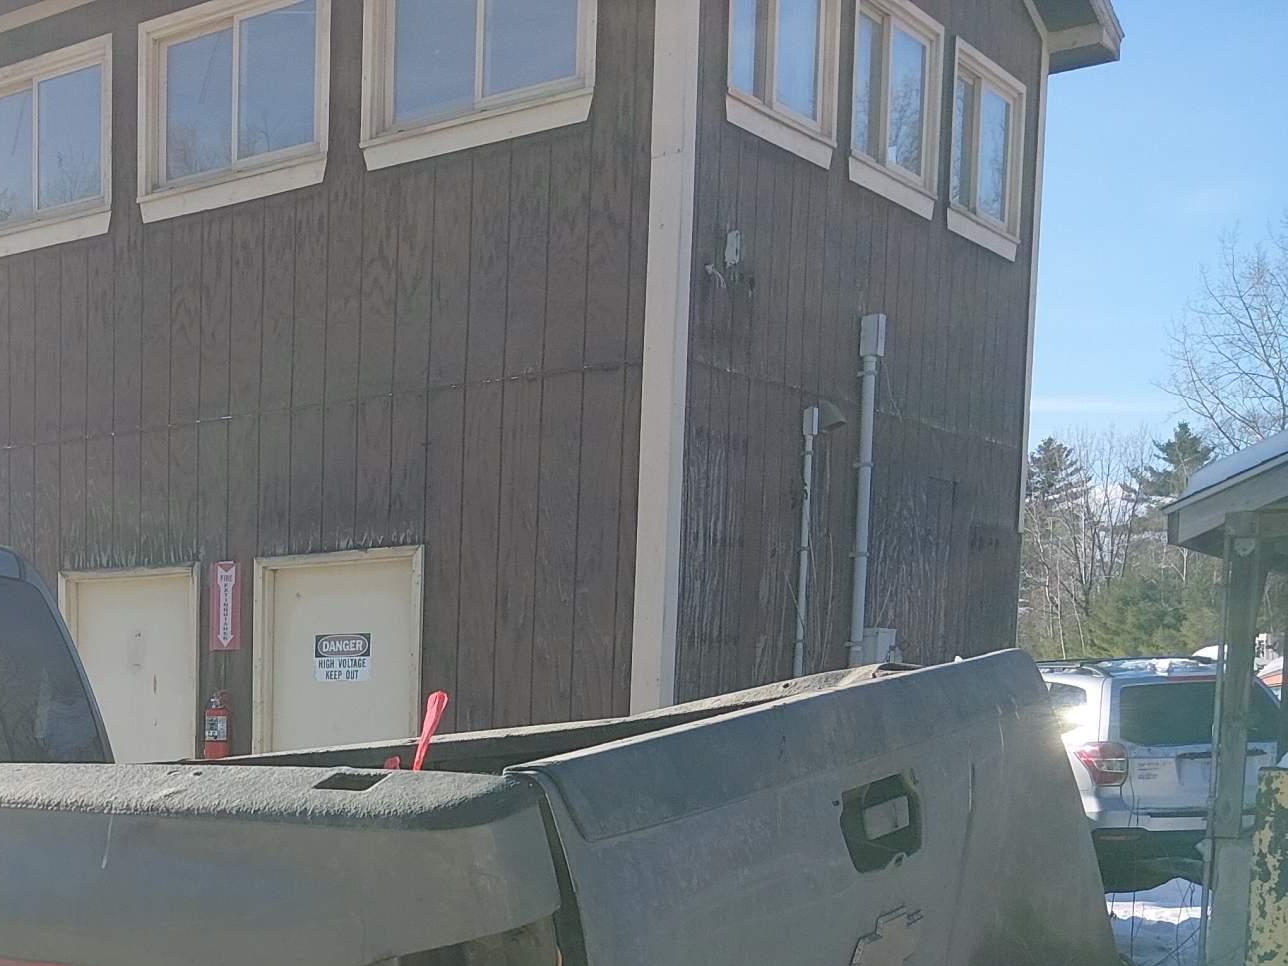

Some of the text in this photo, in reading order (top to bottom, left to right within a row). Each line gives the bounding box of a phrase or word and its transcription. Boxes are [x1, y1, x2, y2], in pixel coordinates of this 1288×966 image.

[322, 640, 363, 652] DANGER
[318, 658, 367, 669] HIGH VOLTAGE
[325, 670, 359, 681] KEEP OUT
